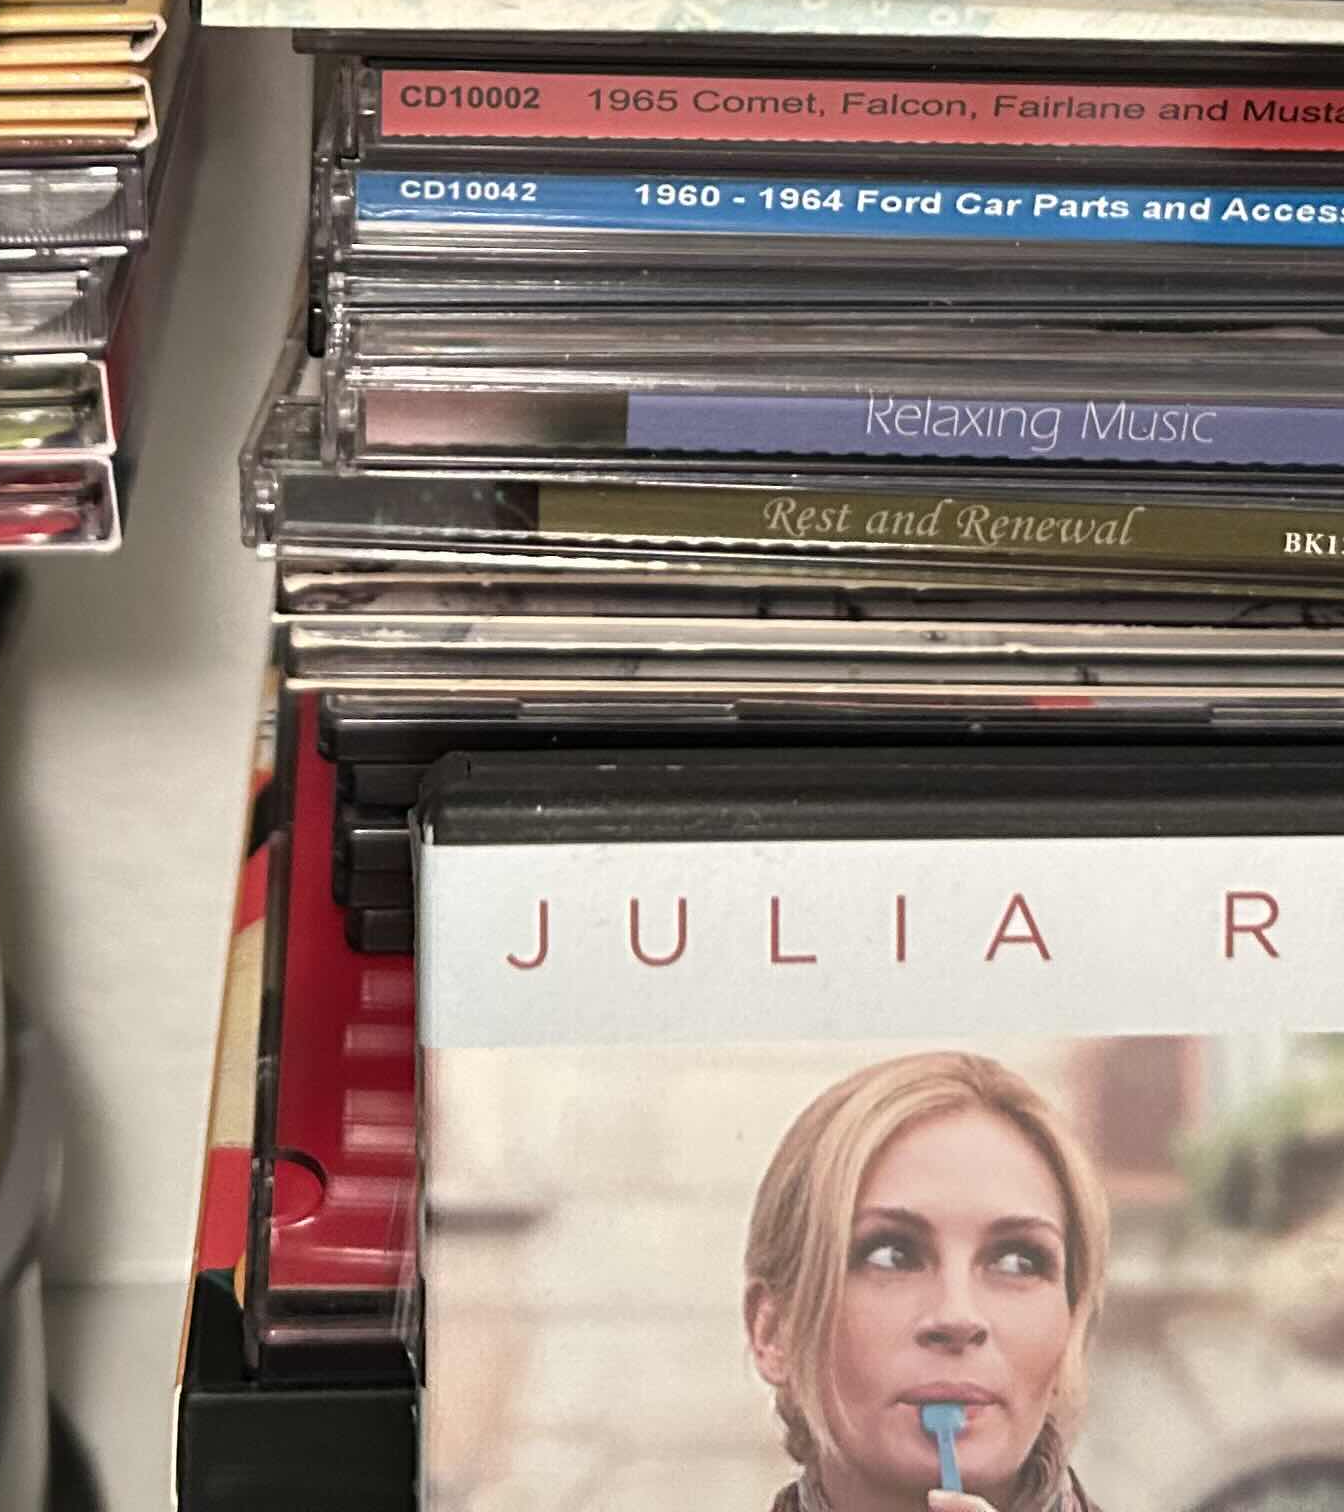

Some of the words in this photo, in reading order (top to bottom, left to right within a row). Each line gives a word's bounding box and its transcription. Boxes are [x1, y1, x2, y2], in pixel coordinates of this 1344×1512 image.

[400, 85, 540, 110] CD10002
[587, 88, 678, 113] 1965
[693, 89, 825, 119] Comet,
[841, 92, 976, 122] Falcon,
[994, 95, 1145, 121] Fairlane
[1158, 98, 1230, 123] and
[400, 180, 537, 202] CD10042
[635, 183, 721, 208] 1960
[759, 188, 845, 213] 1964
[856, 190, 942, 216] Ford
[955, 192, 1022, 218] Car
[1032, 193, 1130, 220] Parts
[1143, 196, 1211, 222] and
[866, 391, 1059, 453] Relaxing
[1081, 401, 1217, 444] Music
[762, 497, 852, 538] Rest
[865, 498, 954, 538] and
[956, 503, 1146, 548] Renewal
[506, 892, 1052, 971] JULIA
